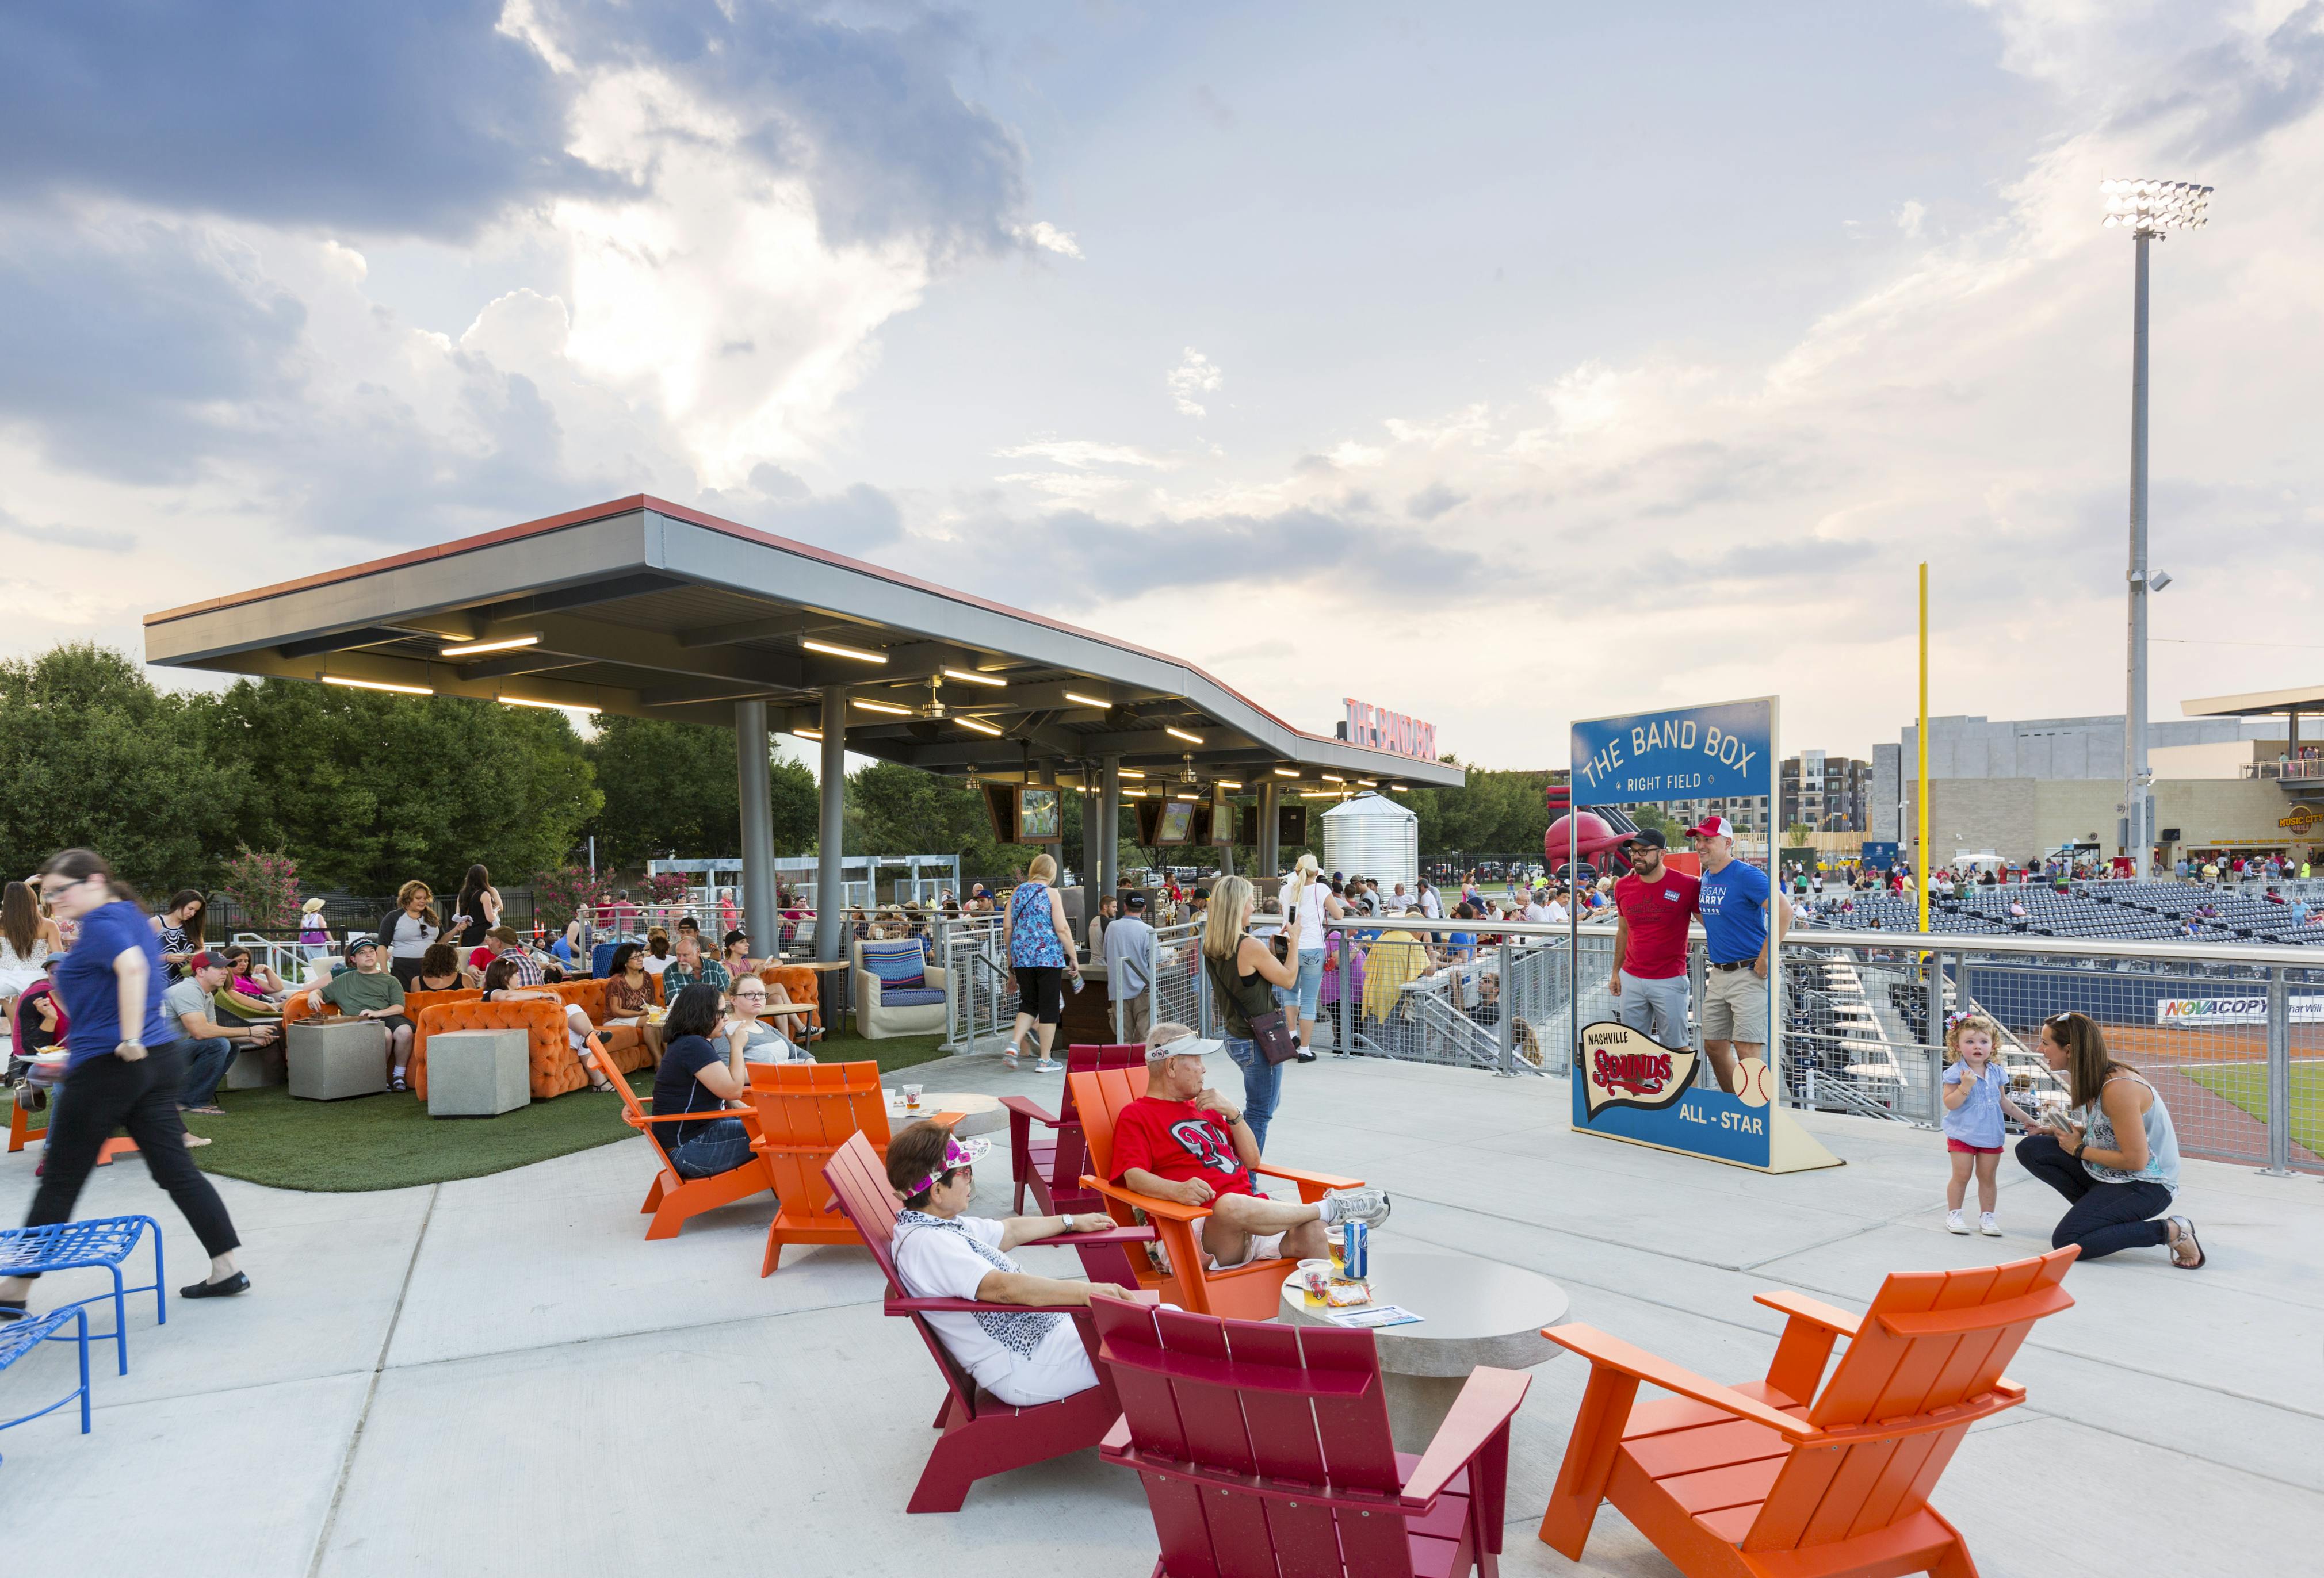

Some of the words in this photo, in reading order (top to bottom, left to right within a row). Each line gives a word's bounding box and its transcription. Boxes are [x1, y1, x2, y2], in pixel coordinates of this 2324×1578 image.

[1343, 698, 1376, 747] THE
[1375, 707, 1413, 756] BAND
[1413, 719, 1437, 760] BOX
[1582, 738, 1624, 788] THE
[1631, 719, 1696, 756] BAND
[1704, 726, 1756, 778] BOX
[1627, 776, 1661, 792] RIGHT
[1667, 773, 1701, 789] FIELD
[2279, 817, 2303, 827] MUSIC
[2305, 814, 2323, 823] CITY
[2165, 999, 2268, 1016] NOVACOPY
[2288, 1005, 2303, 1013] hat
[2305, 1004, 2322, 1013] Will
[1588, 1031, 1629, 1045] NASHVILLE
[1679, 1104, 1707, 1124] ALL
[1721, 1111, 1763, 1136] STAR
